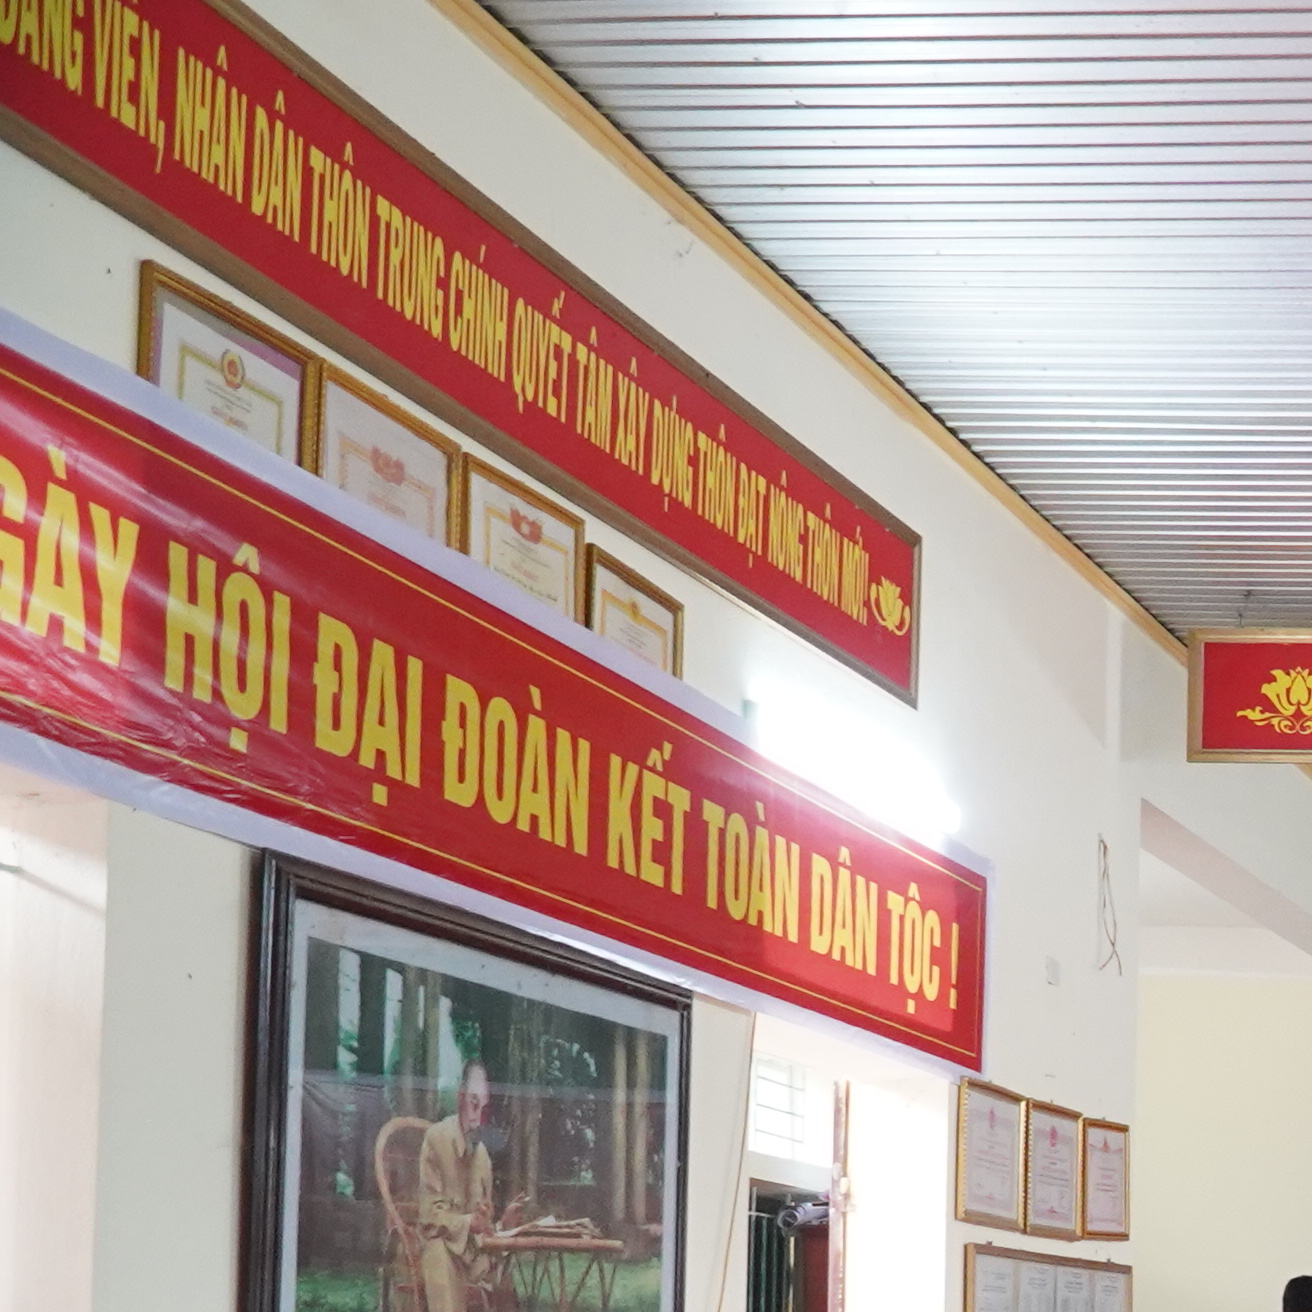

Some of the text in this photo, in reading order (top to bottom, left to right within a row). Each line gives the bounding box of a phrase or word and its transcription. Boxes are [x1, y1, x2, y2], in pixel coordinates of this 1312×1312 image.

[93, 0, 165, 174] VIÊN,
[174, 45, 247, 203] NHÂN
[251, 89, 304, 243] DÂN
[309, 141, 371, 289] THÔN
[376, 193, 445, 342] TRUNG
[449, 244, 509, 383] CHÍNH
[512, 290, 573, 424] QUYẾT
[576, 325, 614, 454] TÂM
[614, 356, 650, 476] XÂY
[651, 394, 694, 512] DỰNG
[697, 423, 736, 537] THÔN
[737, 461, 767, 568] ĐẠT
[767, 469, 804, 584] NÔNG
[806, 502, 841, 608] THÔN
[163, 542, 291, 753] HỘI
[313, 611, 423, 807] ĐẠI
[441, 673, 591, 857] ĐOÀN
[606, 740, 691, 896] KẾT
[702, 798, 800, 944] TOÀN
[810, 845, 879, 976] DÂN
[886, 881, 942, 1014] TỘC
[949, 922, 960, 1010] !
